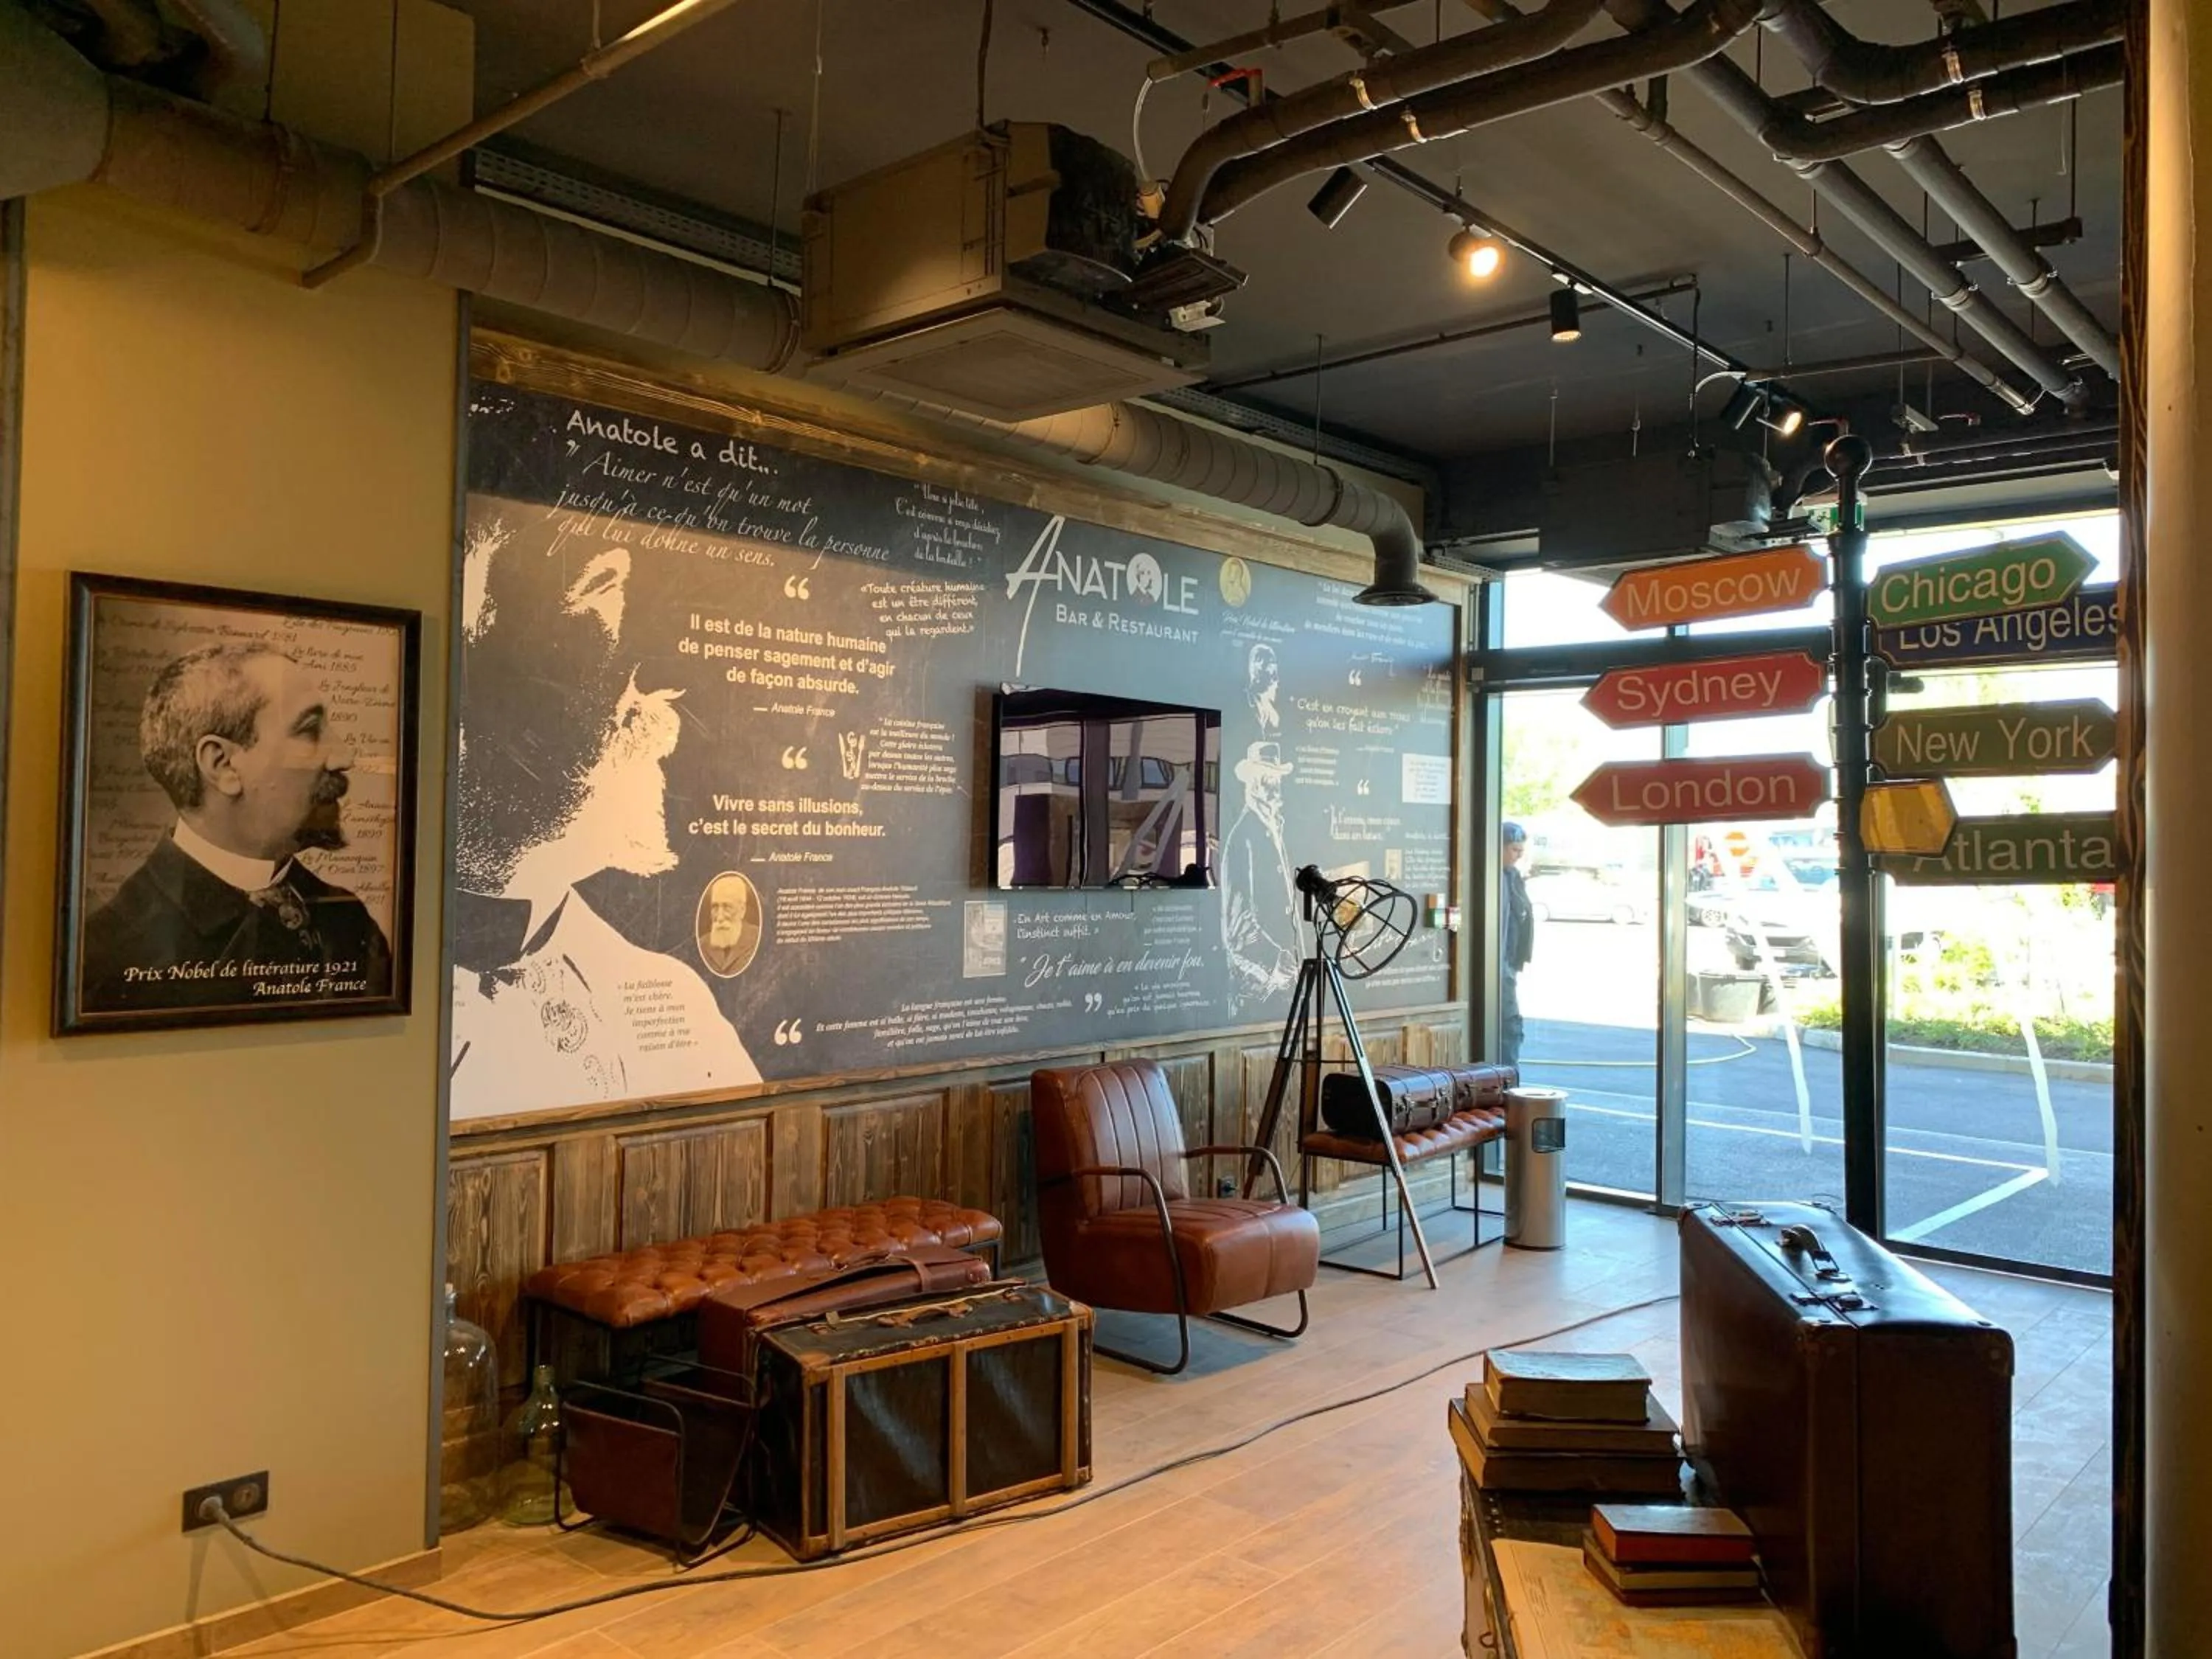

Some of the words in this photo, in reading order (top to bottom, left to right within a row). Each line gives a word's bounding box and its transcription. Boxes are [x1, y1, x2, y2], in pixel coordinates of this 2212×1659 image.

[566, 409, 678, 454] Anatole
[690, 442, 706, 461] a
[582, 451, 656, 483] Aimer
[661, 467, 712, 495] n'est
[711, 480, 772, 518] qu'un
[777, 497, 812, 515] mot
[546, 483, 638, 527] jusqu'à
[737, 517, 792, 543] trouve
[799, 516, 819, 548] la
[810, 535, 891, 570] personne
[602, 509, 635, 543] lui
[706, 540, 732, 560] un
[734, 549, 775, 567] sens.
[872, 599, 888, 608] est
[900, 580, 942, 593] créature
[945, 581, 986, 592] humaine
[1626, 568, 1801, 618] Moscow
[1882, 558, 2056, 613] Chicago
[690, 613, 700, 630] Il
[704, 617, 731, 635] est
[734, 619, 754, 637] de
[758, 622, 772, 639] la
[776, 625, 823, 645] nature
[827, 631, 887, 654] humaine
[879, 613, 891, 622] en
[896, 611, 932, 622] chacun
[935, 610, 948, 620] de
[886, 625, 902, 643] qui
[905, 625, 915, 636] la
[1056, 604, 1088, 627] BAR
[1091, 611, 1105, 628] &
[1108, 612, 1200, 645] RESTAURANT
[678, 637, 700, 655] de
[704, 641, 760, 660] penser
[763, 649, 837, 672] sagement
[838, 658, 853, 672] et
[856, 658, 897, 680] d'agir
[726, 666, 746, 684] de
[750, 667, 793, 689] façon
[797, 673, 860, 695] absurde.
[1617, 669, 1782, 717] Sydney
[771, 702, 804, 715] Anatole
[806, 704, 836, 718] France
[1896, 723, 1980, 765] New
[1997, 714, 2093, 760] York
[712, 793, 754, 812] Vivre
[758, 799, 795, 814] sans
[799, 796, 863, 816] illusions,
[1611, 770, 1795, 811] London
[689, 818, 728, 835] c'est
[733, 819, 747, 835] le
[751, 820, 798, 836] secret
[802, 820, 821, 836] du
[825, 820, 886, 838] bonheur.
[768, 852, 802, 863] Anatole
[804, 852, 833, 863] France
[1034, 912, 1051, 922] Art
[1053, 913, 1088, 922] comme
[124, 965, 163, 982] Prix
[167, 959, 216, 980] Nobel
[220, 960, 237, 977] de
[242, 958, 319, 977] littérature
[324, 961, 358, 975] 1921
[253, 975, 311, 996] Anatole
[316, 978, 367, 992] France
[1024, 953, 1054, 988] Je
[1055, 953, 1103, 978] t'aime
[1104, 956, 1114, 974] à
[1116, 960, 1133, 973] en
[1135, 950, 1180, 972] devenir
